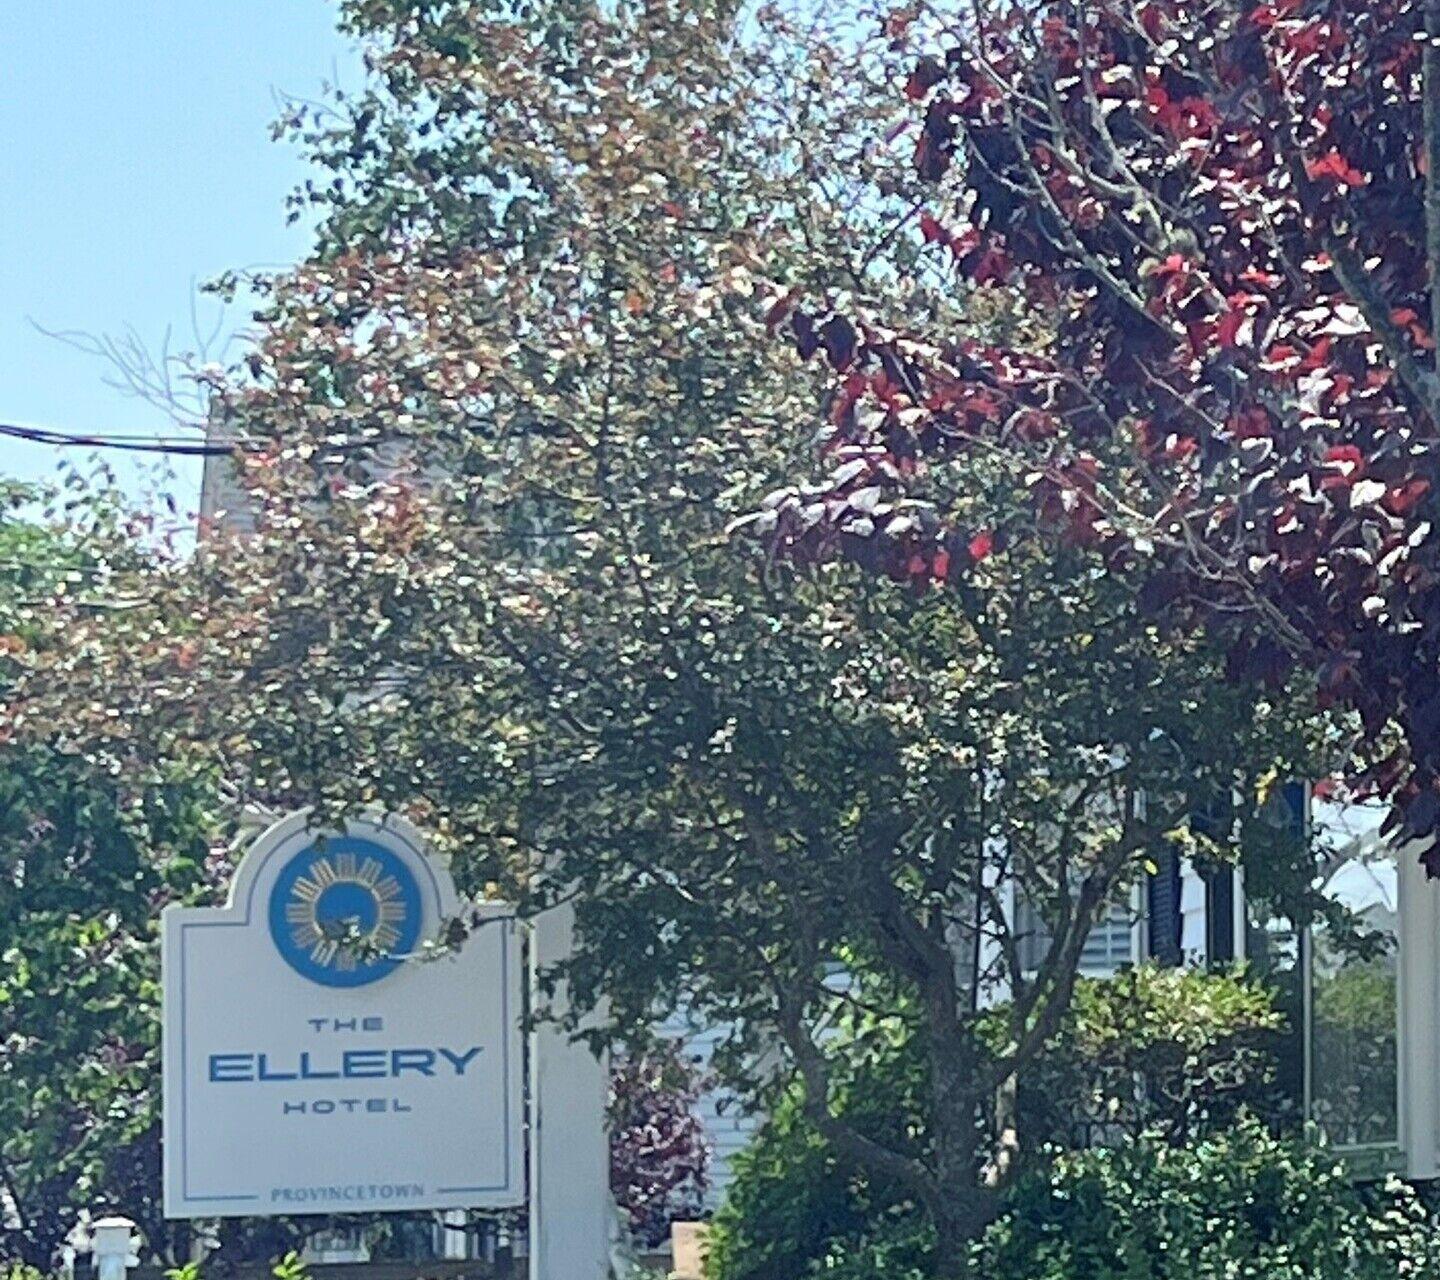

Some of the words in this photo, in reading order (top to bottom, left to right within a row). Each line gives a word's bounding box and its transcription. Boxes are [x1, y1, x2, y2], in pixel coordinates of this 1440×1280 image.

[308, 1016, 384, 1032] THE
[208, 1047, 483, 1082] ELLERY
[282, 1098, 412, 1115] HOTEL
[271, 1184, 425, 1202] PROVINCETOWN
